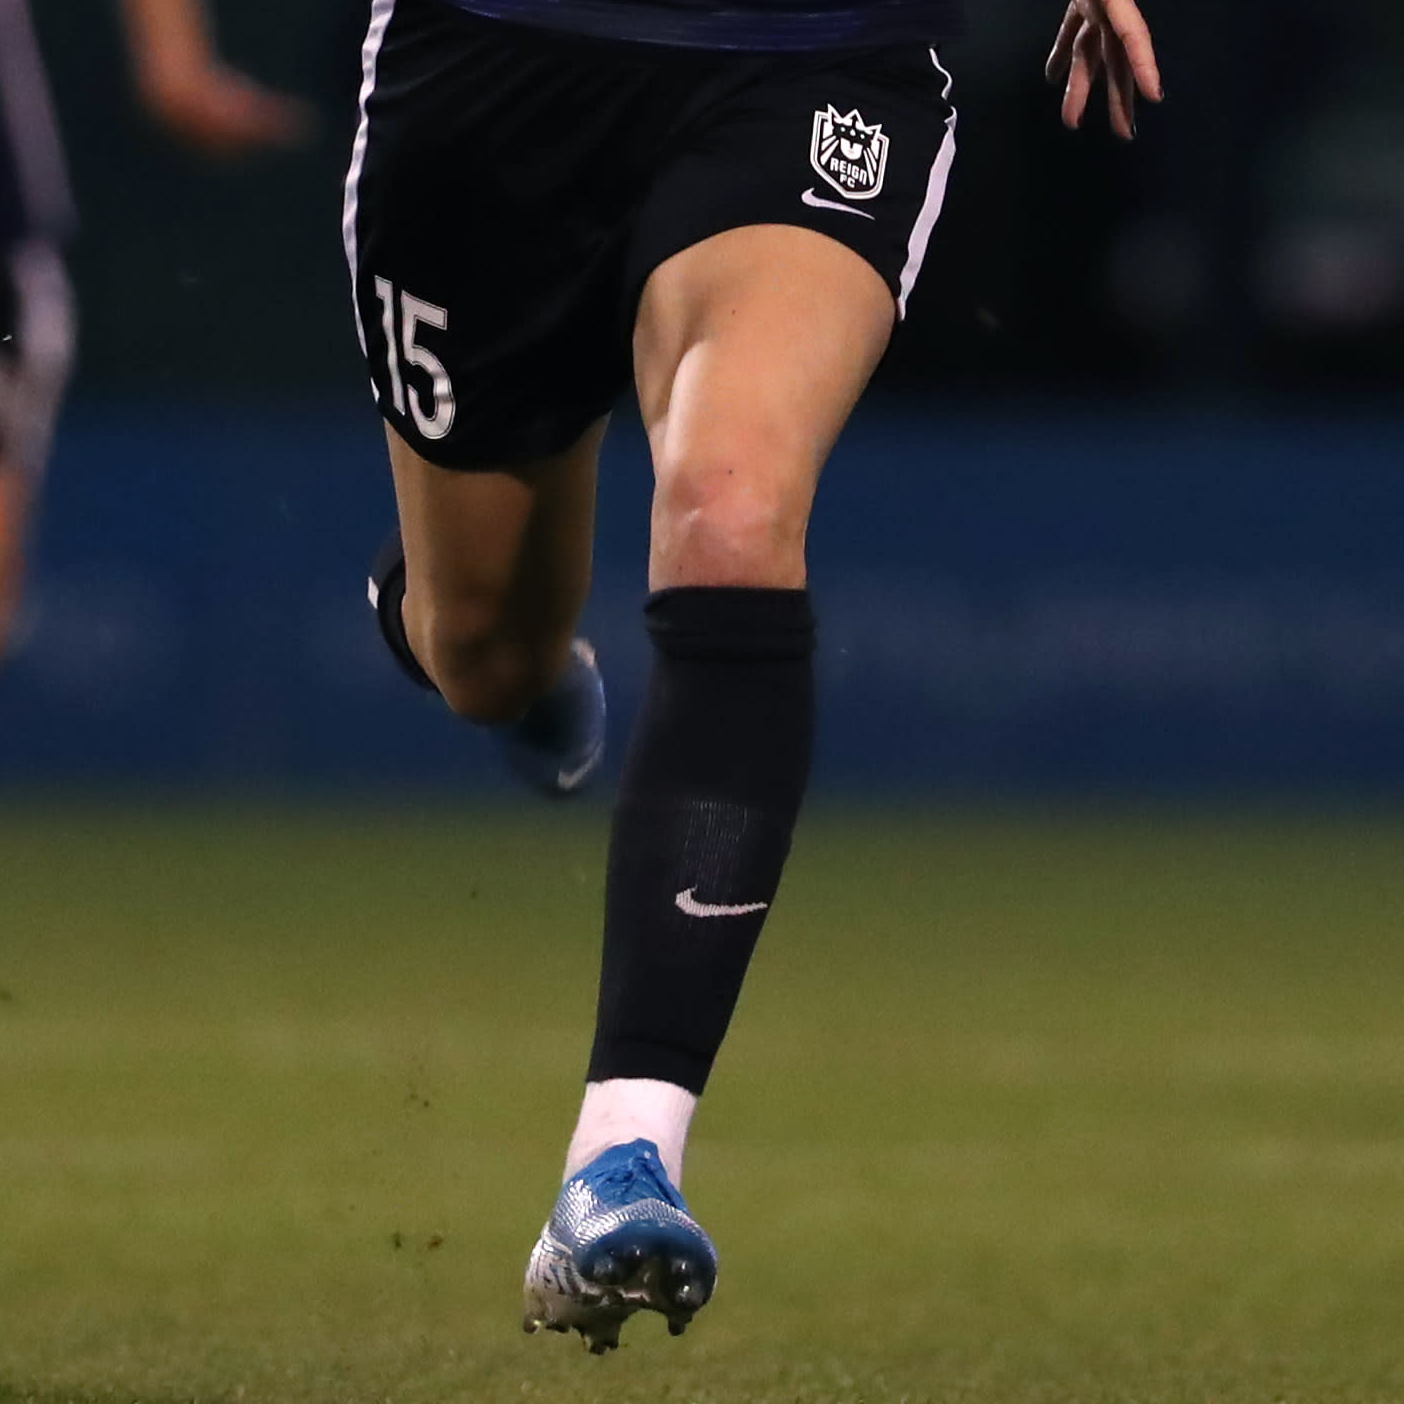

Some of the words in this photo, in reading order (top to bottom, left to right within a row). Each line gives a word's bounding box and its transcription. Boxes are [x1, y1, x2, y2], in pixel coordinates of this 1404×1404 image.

[830, 157, 868, 186] REIGN
[840, 174, 856, 188] FC
[374, 274, 456, 439] 15
